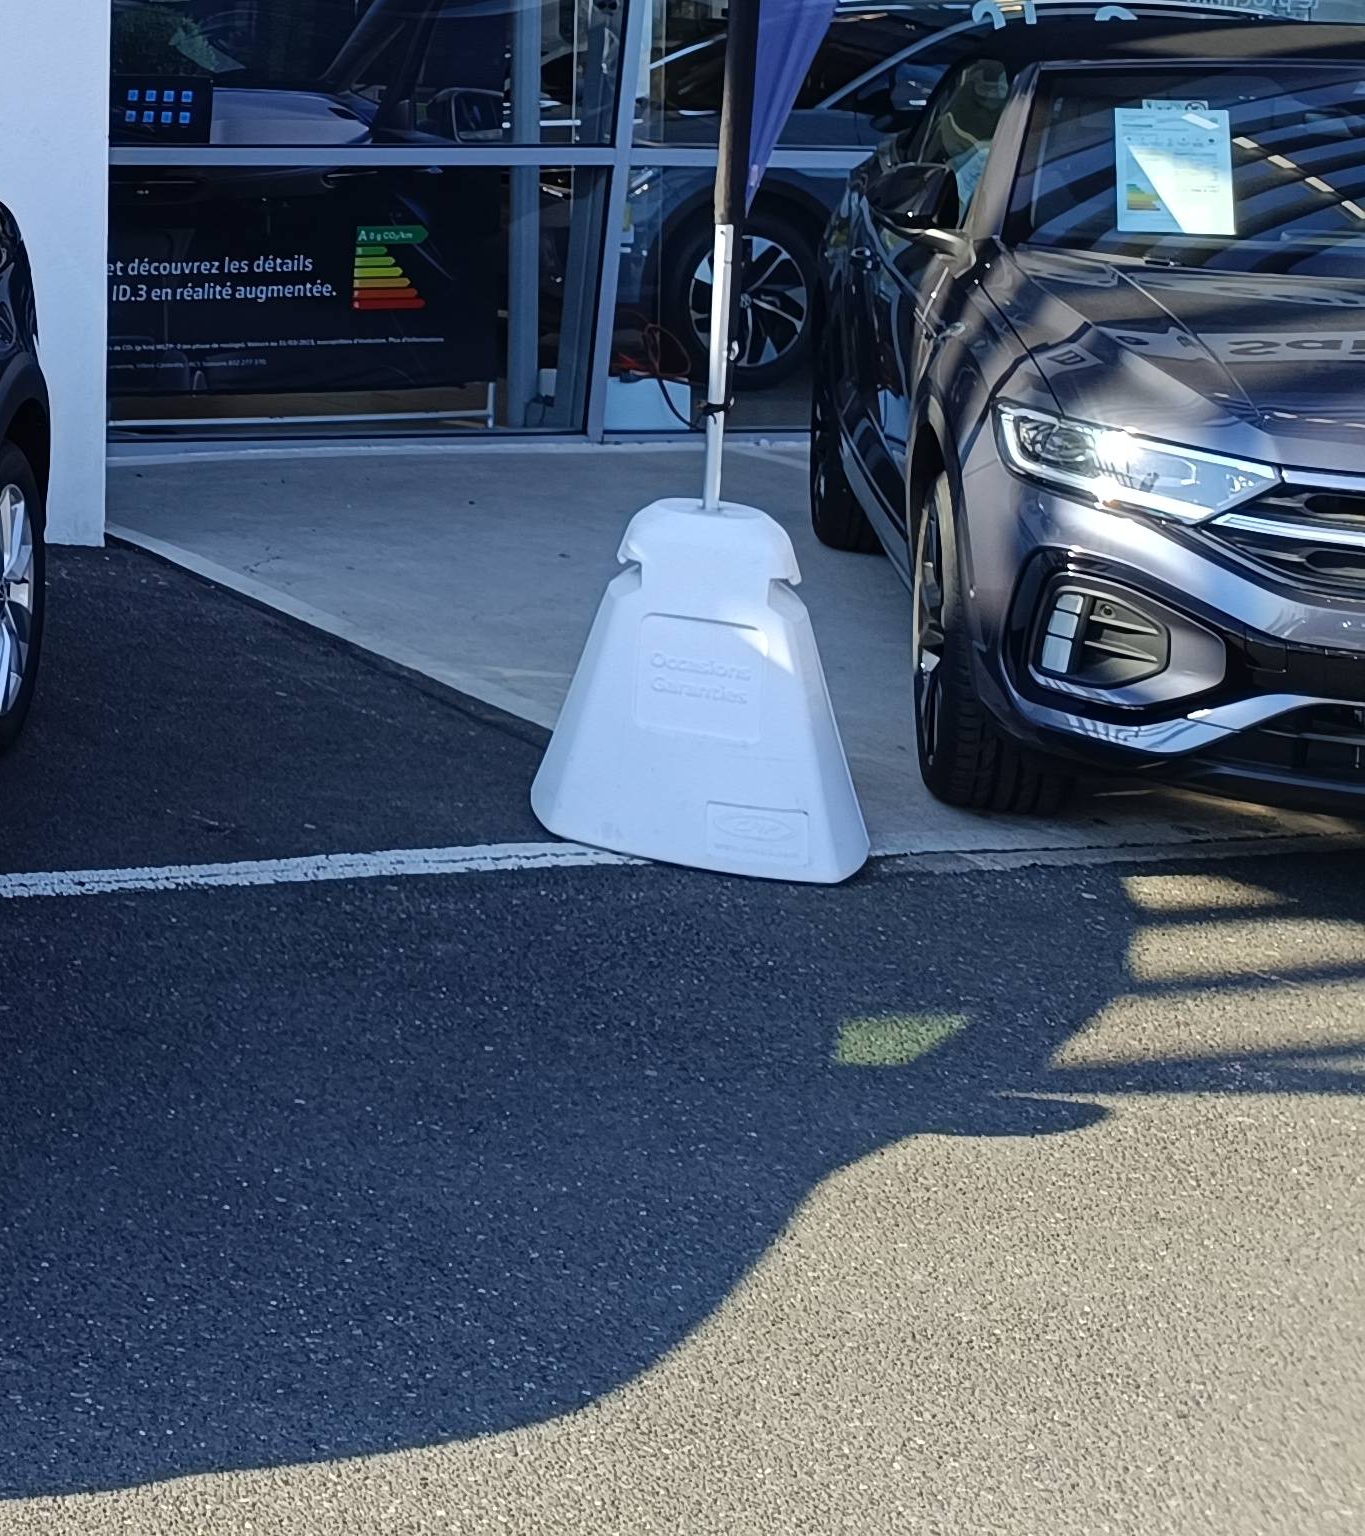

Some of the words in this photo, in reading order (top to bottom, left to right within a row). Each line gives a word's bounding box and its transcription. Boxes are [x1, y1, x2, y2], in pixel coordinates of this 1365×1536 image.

[128, 257, 220, 276] découvrez
[224, 255, 249, 273] les
[253, 254, 313, 273] détails
[112, 284, 146, 301] ID.3
[151, 286, 172, 301] en
[176, 281, 232, 301] réalité
[235, 280, 337, 303] augmentée.
